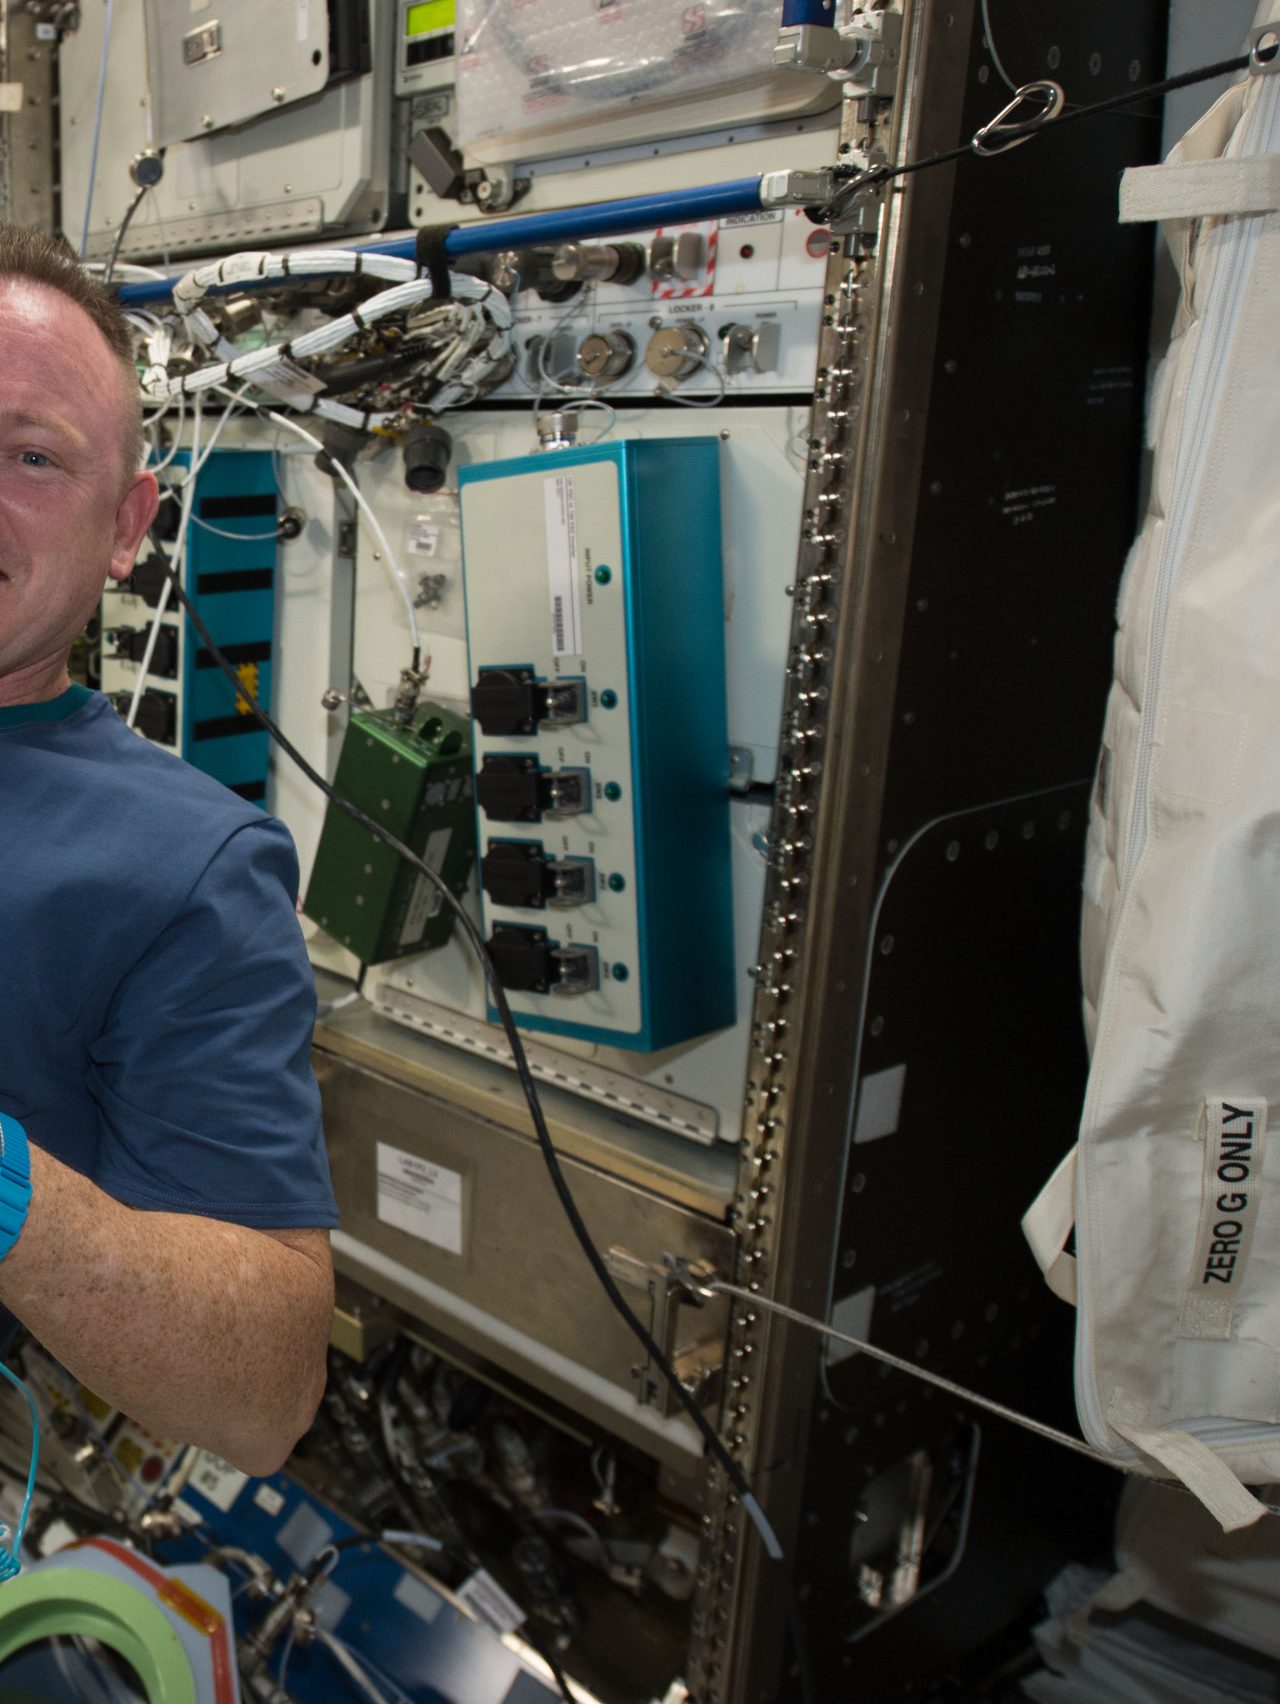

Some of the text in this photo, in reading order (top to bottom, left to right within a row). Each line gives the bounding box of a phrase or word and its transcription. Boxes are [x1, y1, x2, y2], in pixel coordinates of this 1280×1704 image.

[726, 211, 776, 226] INDICATION
[668, 304, 703, 314] LOCKER
[584, 547, 592, 572] INPUT
[1203, 1102, 1254, 1284] ZERO G ONLY
